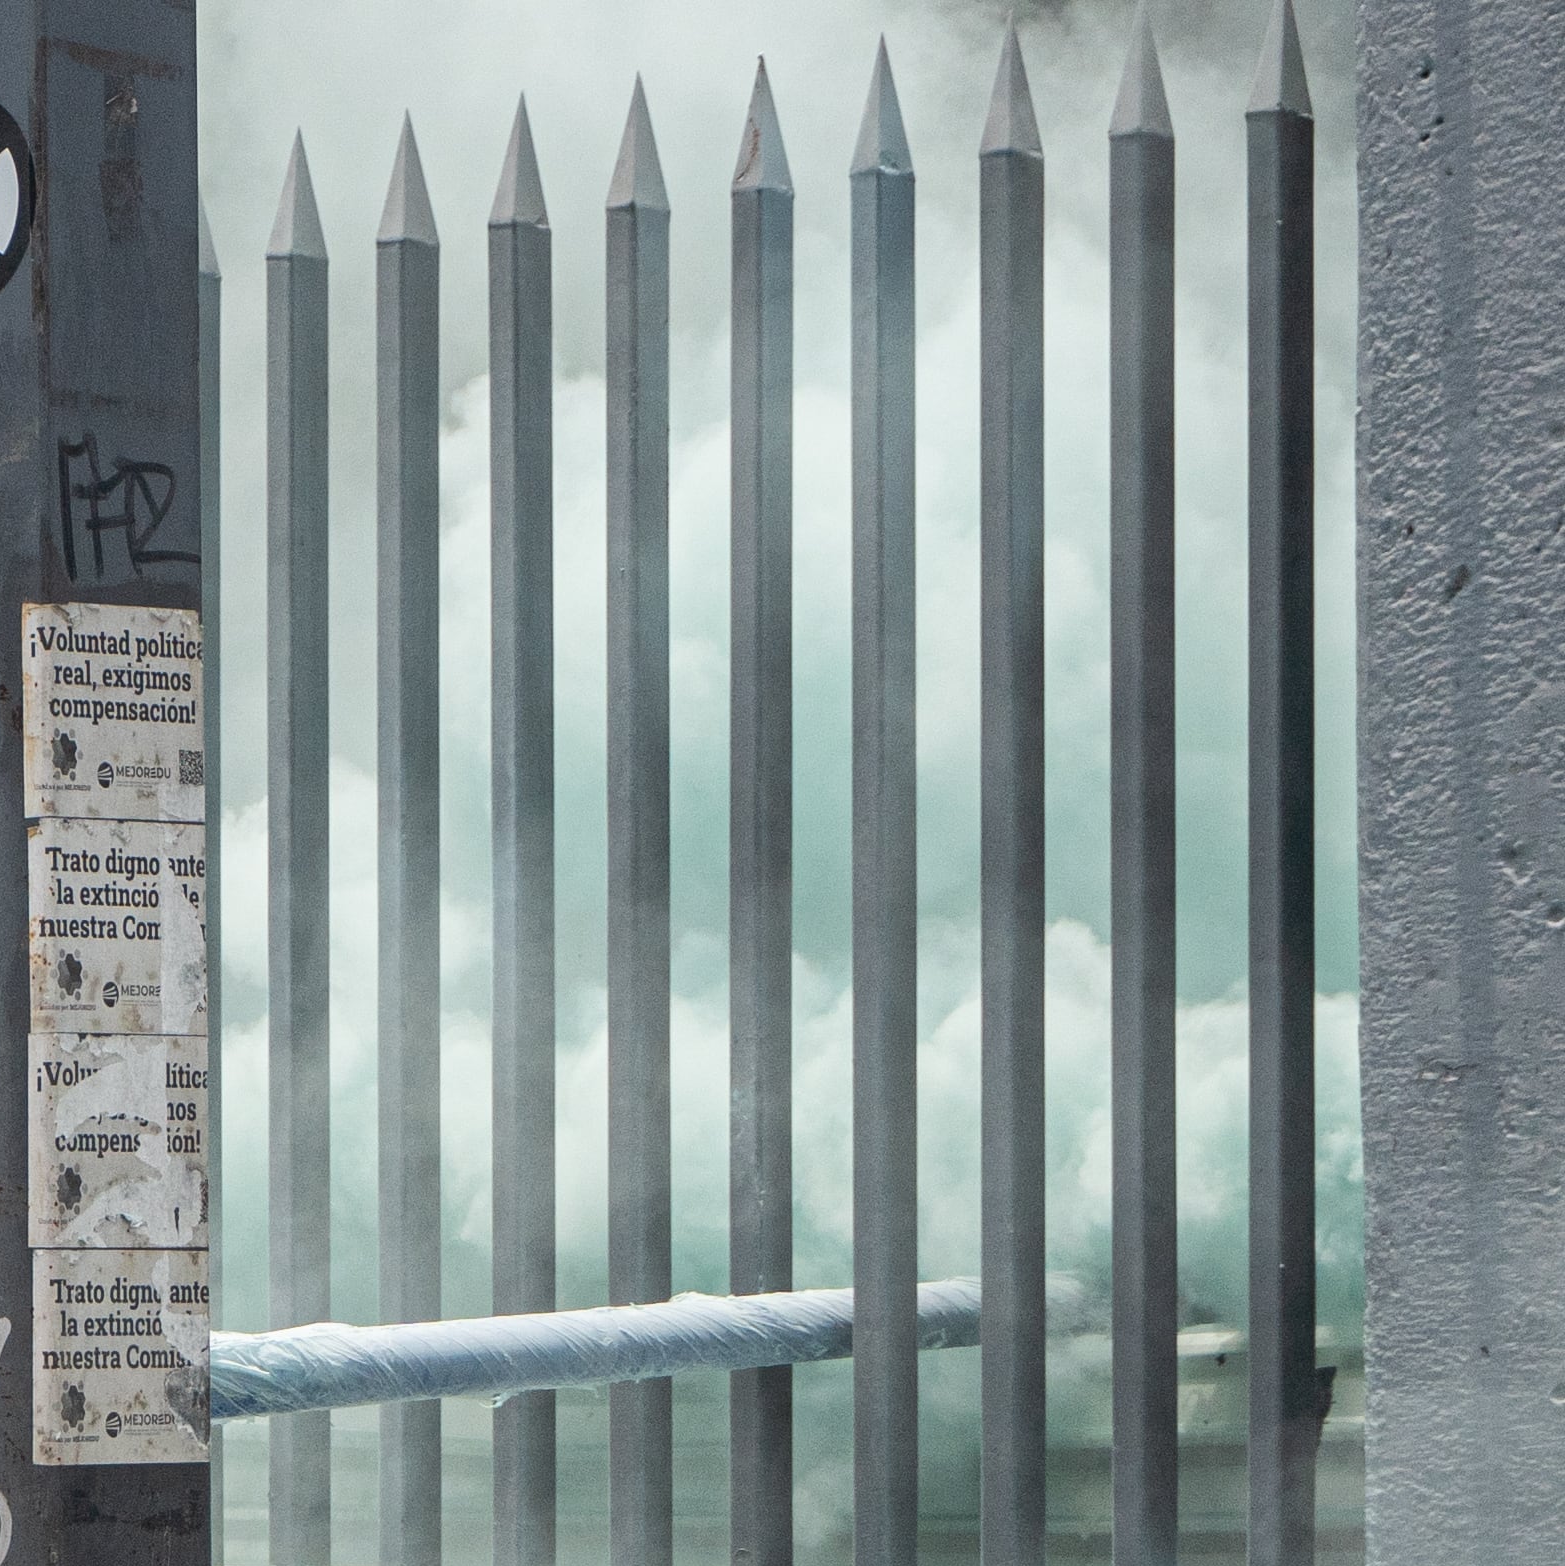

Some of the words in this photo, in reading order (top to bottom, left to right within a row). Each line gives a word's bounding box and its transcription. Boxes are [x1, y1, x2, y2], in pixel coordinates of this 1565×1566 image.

[30, 625, 131, 658] ¡Voluntad
[53, 659, 97, 692] real,
[102, 662, 192, 695] exigimos
[49, 697, 196, 726] compensación!
[115, 765, 171, 779] MEJOREDU
[44, 846, 101, 873] Trato
[105, 847, 160, 881] digno
[56, 878, 75, 905] la
[79, 881, 160, 908] extinció
[39, 916, 118, 939] nuestra
[121, 984, 161, 997] MEJORE
[166, 1062, 208, 1089] lítica
[55, 1128, 201, 1158] compensión!
[49, 1278, 105, 1304] Trato
[170, 1280, 209, 1303] ante
[60, 1310, 79, 1337] la
[84, 1310, 163, 1336] extinció
[42, 1346, 121, 1370] nuestra
[126, 1344, 192, 1369] Comis
